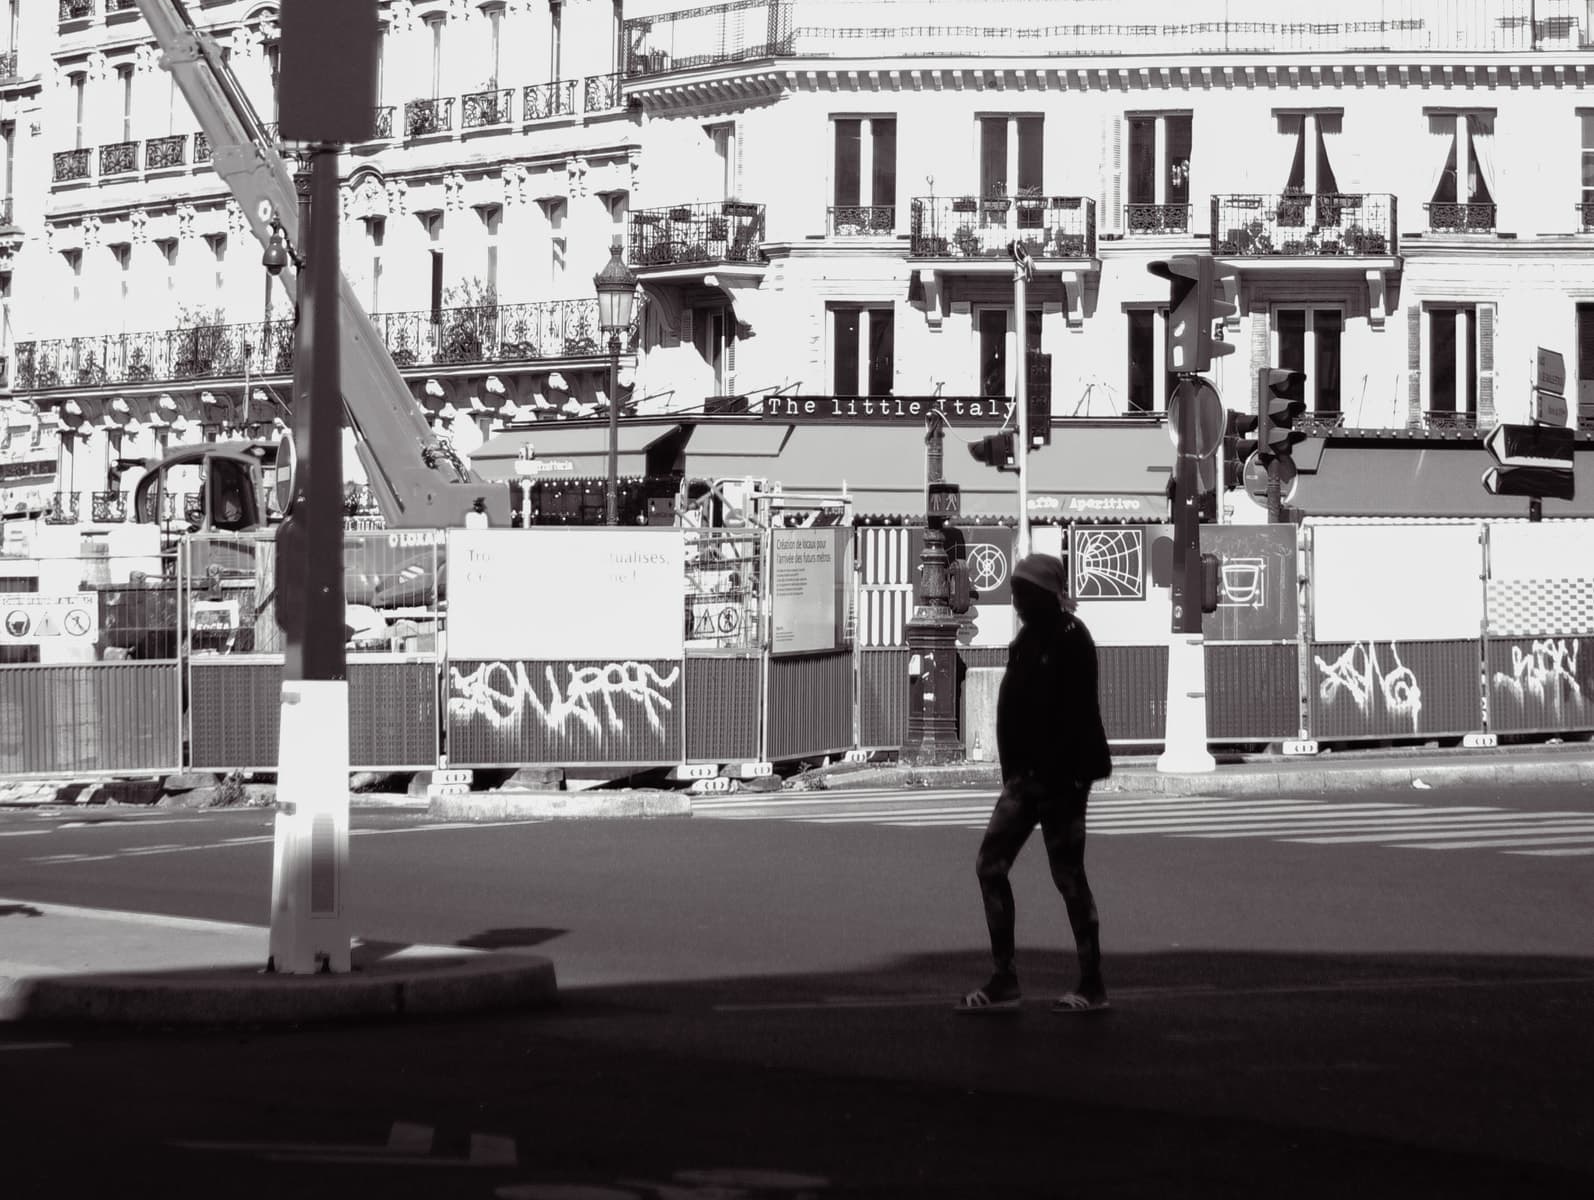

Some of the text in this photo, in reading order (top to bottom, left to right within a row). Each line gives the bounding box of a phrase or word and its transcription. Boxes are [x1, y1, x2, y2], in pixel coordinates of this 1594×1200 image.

[768, 398, 1017, 419] The little Italy
[1069, 497, 1141, 512] Aperitivo
